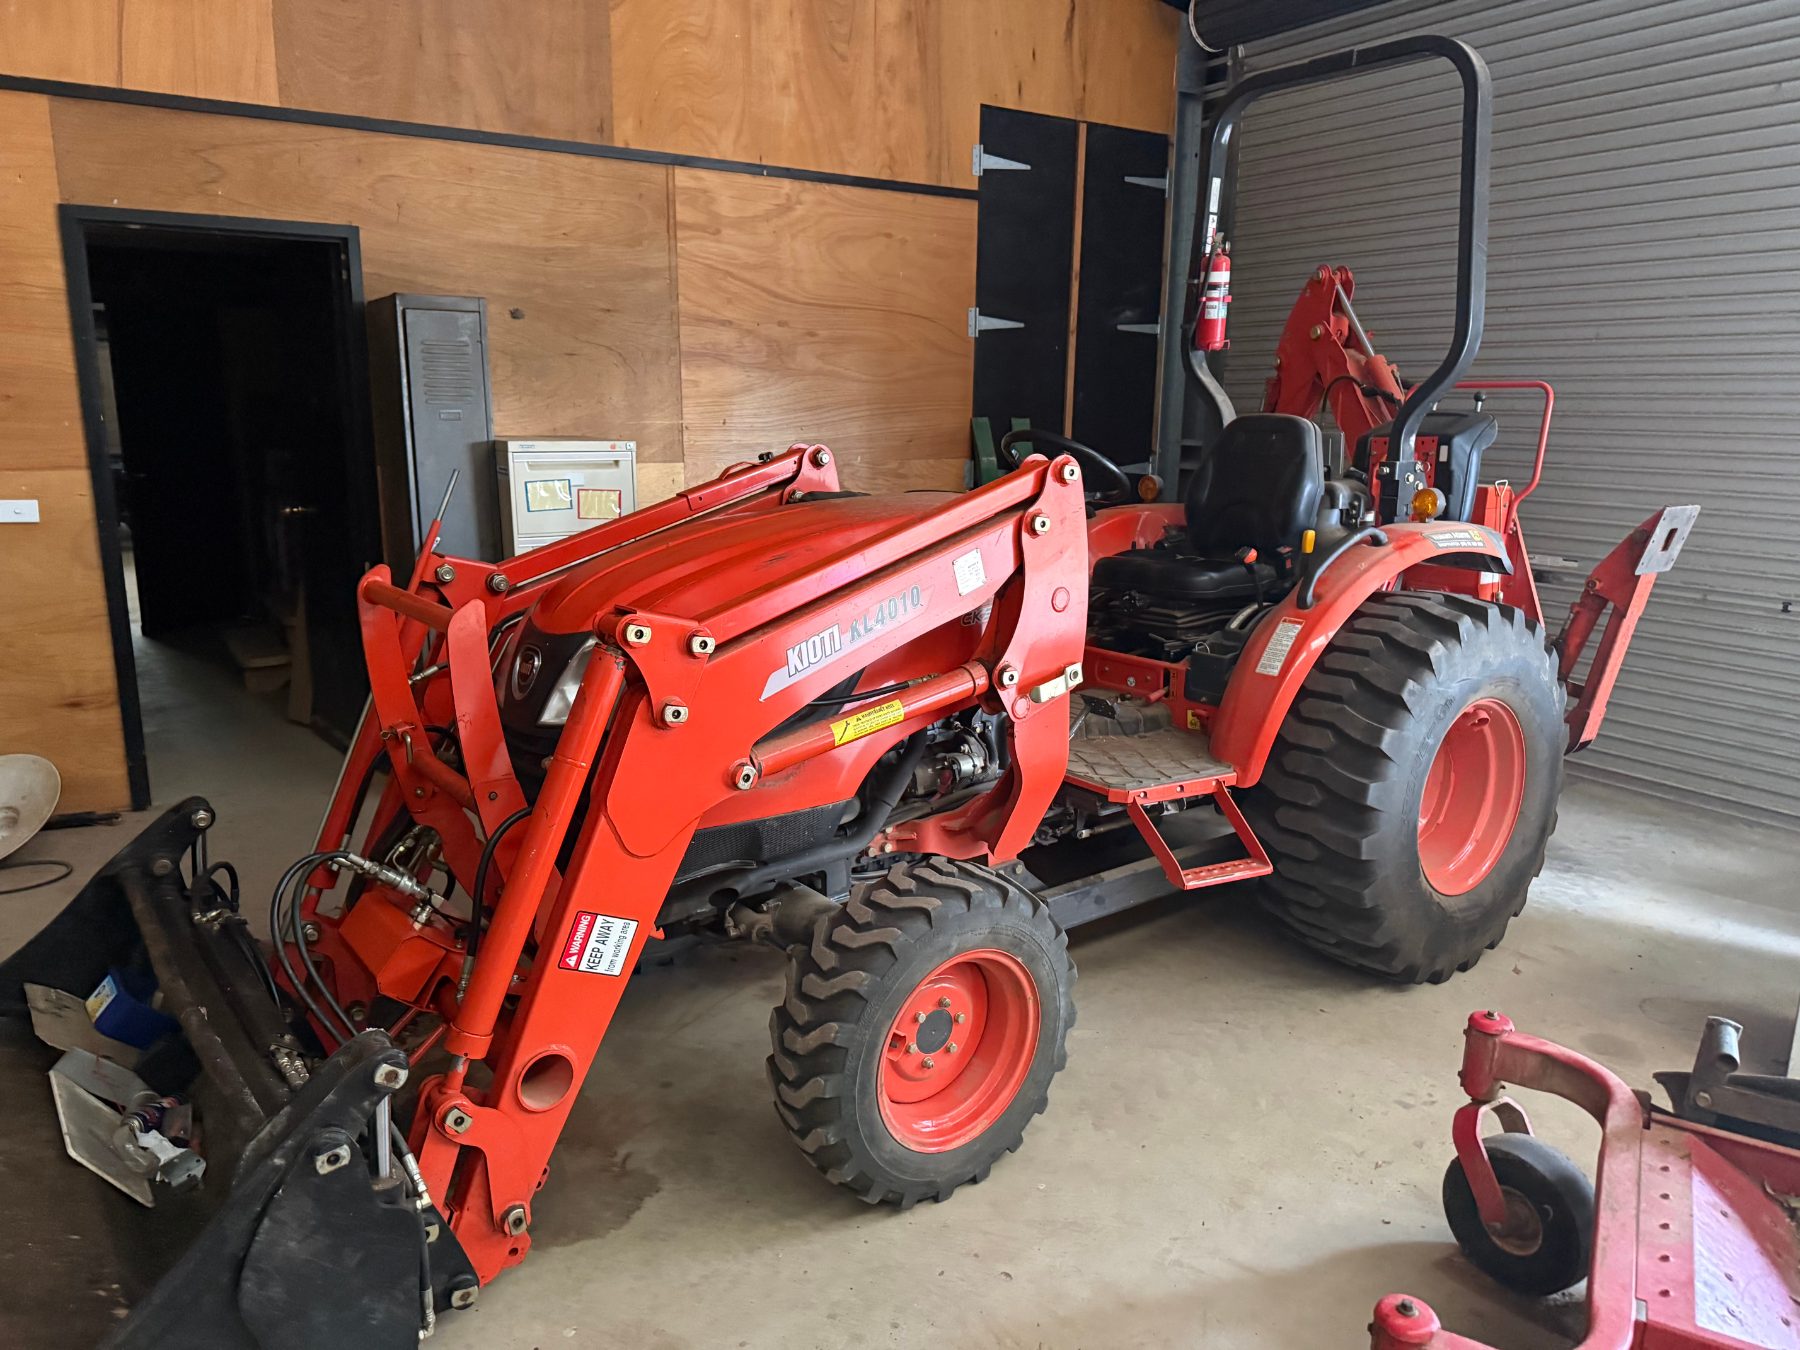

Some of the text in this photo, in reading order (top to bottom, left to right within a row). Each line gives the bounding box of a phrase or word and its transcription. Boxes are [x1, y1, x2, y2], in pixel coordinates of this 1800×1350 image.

[786, 585, 921, 678] KIOTI KL4010
[569, 915, 591, 954] WARNING
[585, 918, 614, 970] KEEP AWAY
[604, 922, 631, 972] from working area
